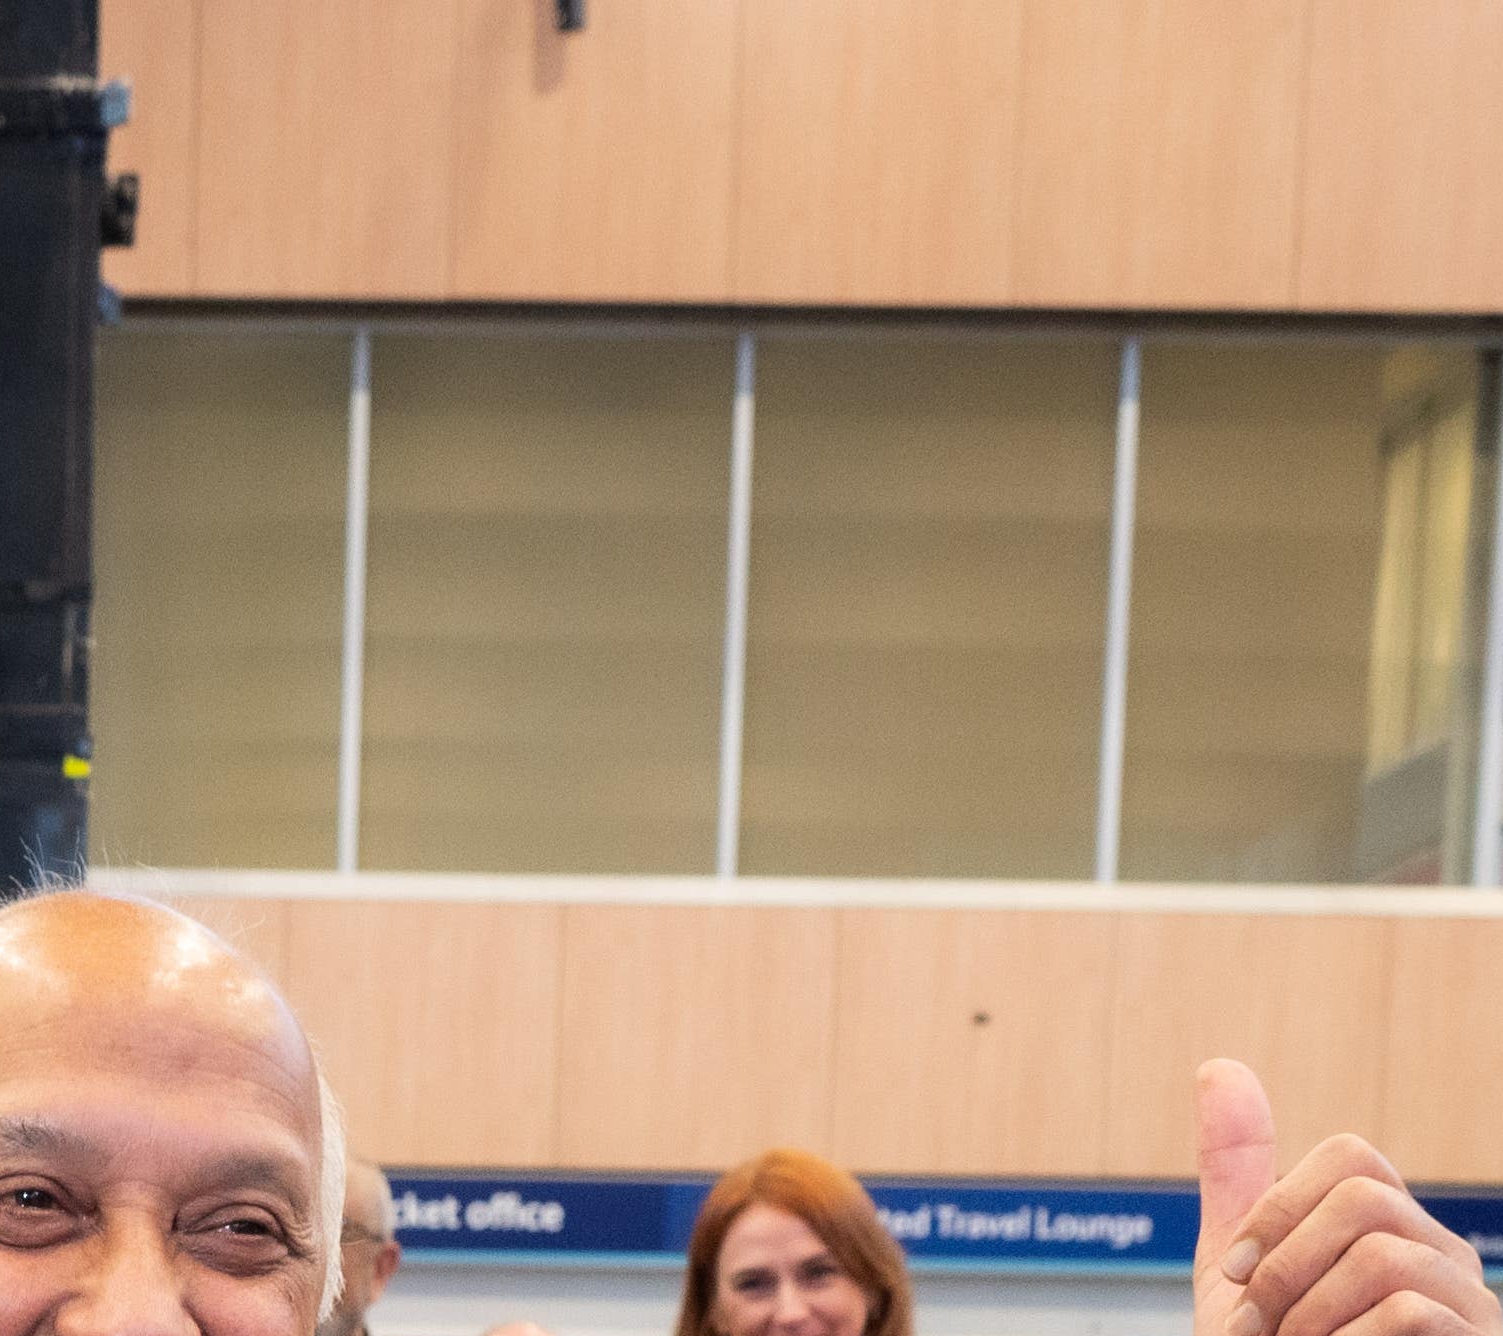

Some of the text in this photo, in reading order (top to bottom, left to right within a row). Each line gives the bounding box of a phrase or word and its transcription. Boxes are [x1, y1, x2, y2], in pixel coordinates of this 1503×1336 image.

[465, 1191, 566, 1233] office
[936, 1204, 1032, 1240] Travel
[1034, 1206, 1153, 1249] Lounge
